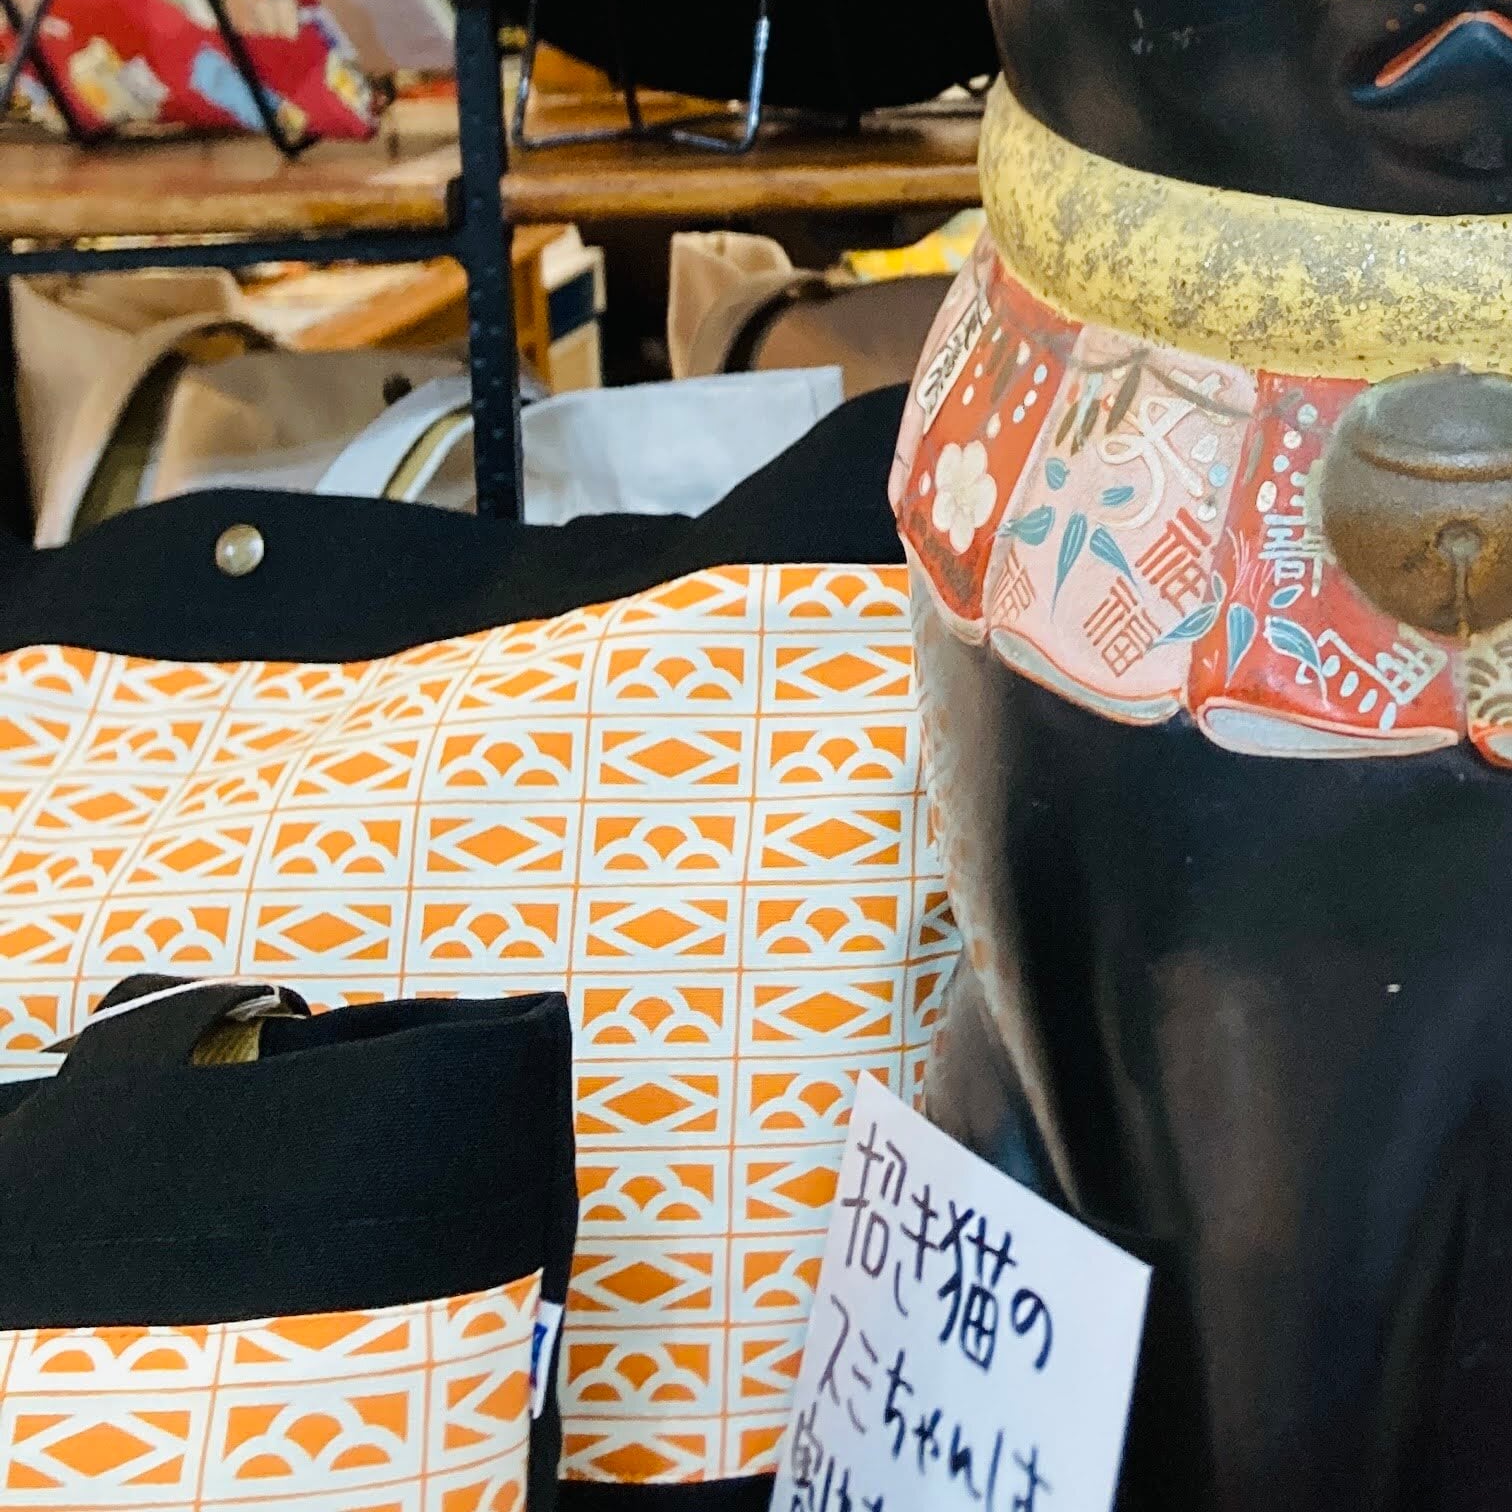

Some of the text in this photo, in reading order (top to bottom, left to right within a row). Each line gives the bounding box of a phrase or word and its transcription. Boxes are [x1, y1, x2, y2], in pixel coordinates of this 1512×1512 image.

[1082, 574, 1163, 679] 福
[841, 1121, 1055, 1372] 招き猫の
